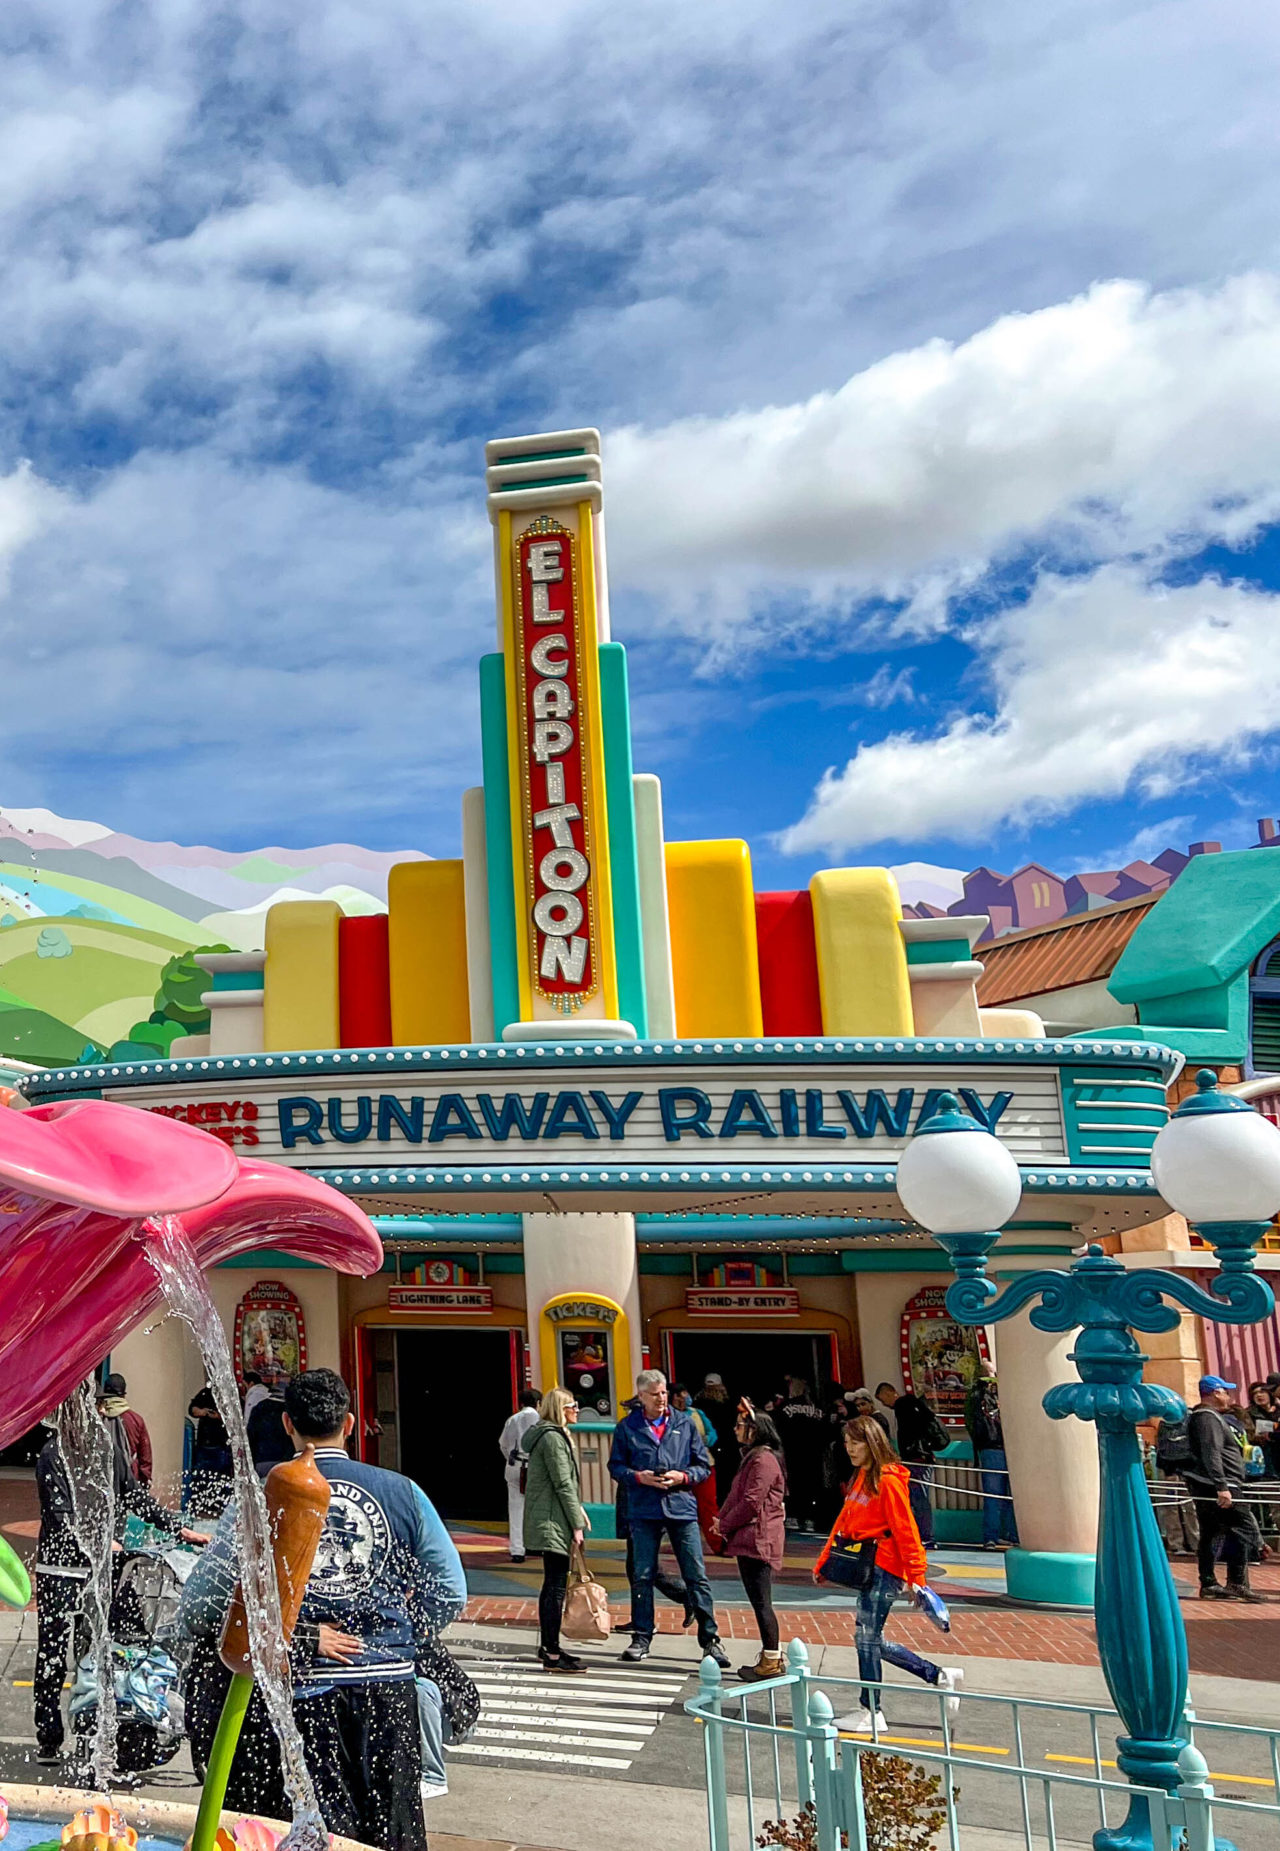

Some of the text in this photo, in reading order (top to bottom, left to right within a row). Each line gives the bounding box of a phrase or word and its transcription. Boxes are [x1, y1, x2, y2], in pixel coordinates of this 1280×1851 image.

[526, 540, 590, 985] EL CAPITOON
[277, 1089, 644, 1149] RUNAWAY
[258, 1283, 280, 1291] NOW
[249, 1291, 290, 1300] SHOWING
[399, 1294, 483, 1305] LIGHTNING LANE
[697, 1296, 787, 1307] STAND-BY ENTRY
[544, 1302, 619, 1324] TICKETS
[362, 1501, 388, 1550] ONLY
